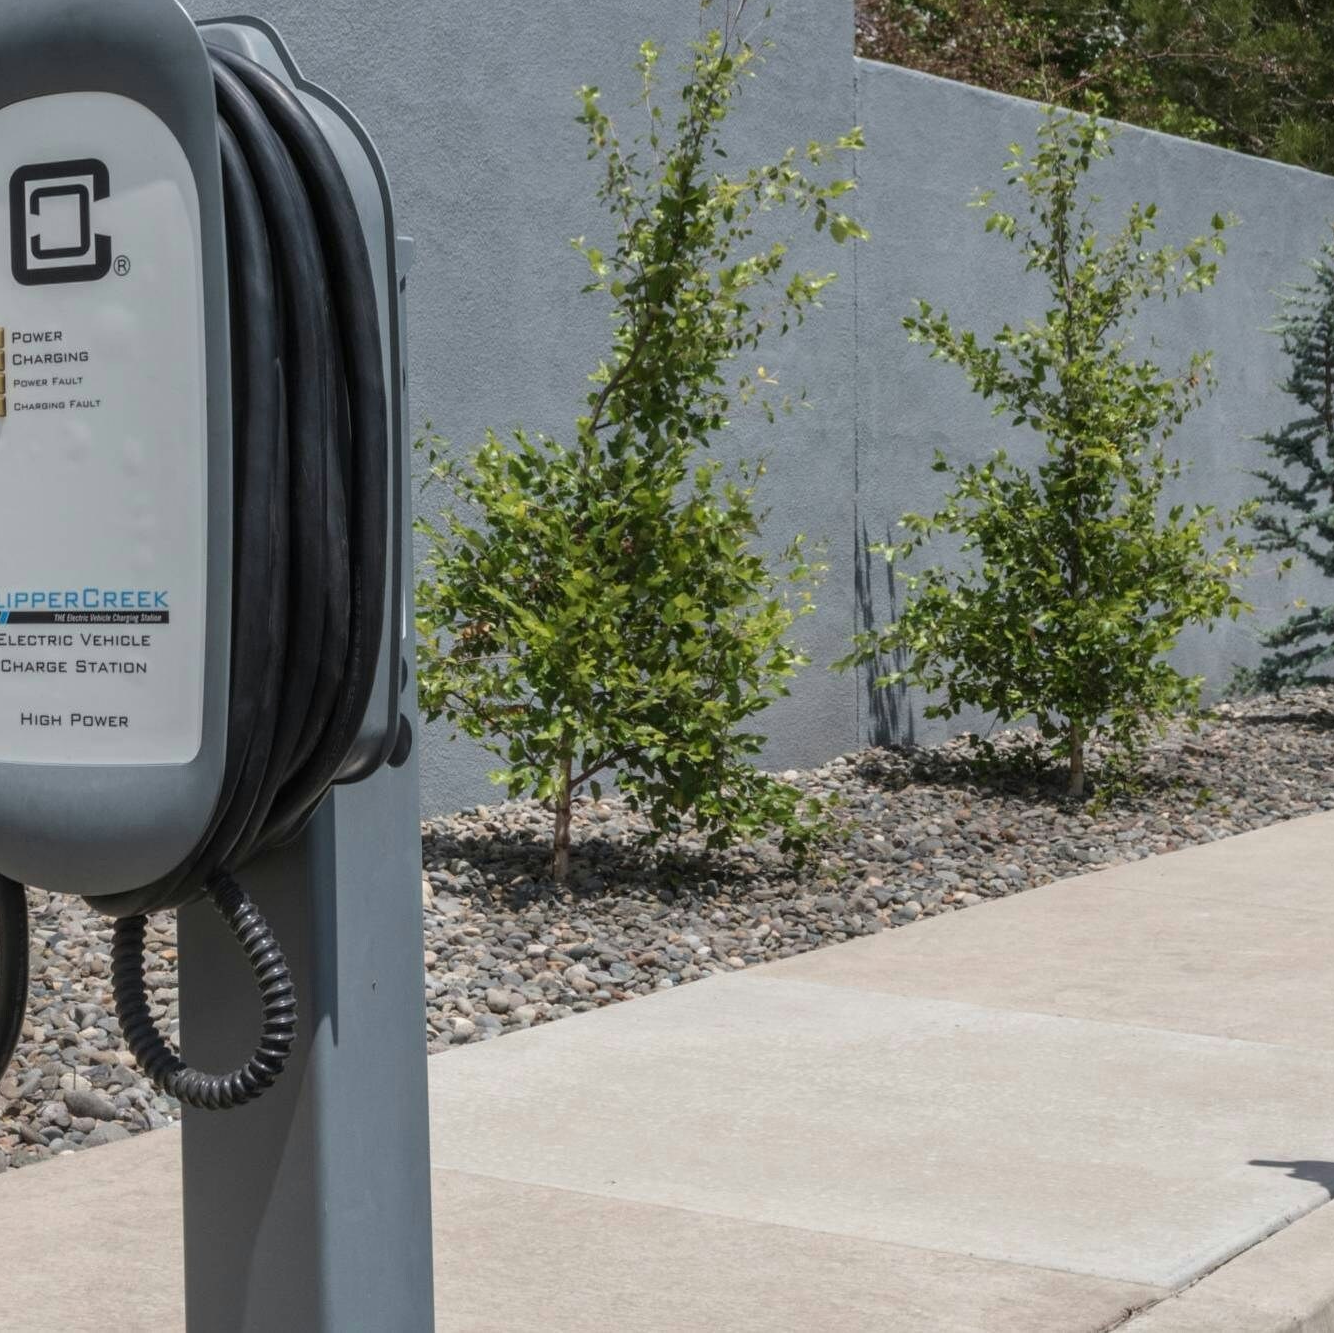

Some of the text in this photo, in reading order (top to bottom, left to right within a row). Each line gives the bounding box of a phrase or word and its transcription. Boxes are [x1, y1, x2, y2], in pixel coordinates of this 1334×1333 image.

[11, 331, 63, 344] POWER
[12, 351, 89, 366] CHARGING
[13, 377, 83, 388] POWER FAULT
[14, 400, 101, 411] CHARGING FAULT
[80, 633, 151, 646] VEHICLE
[1, 659, 147, 674] CHARGE STATION
[20, 713, 129, 727] HIGH POWER
